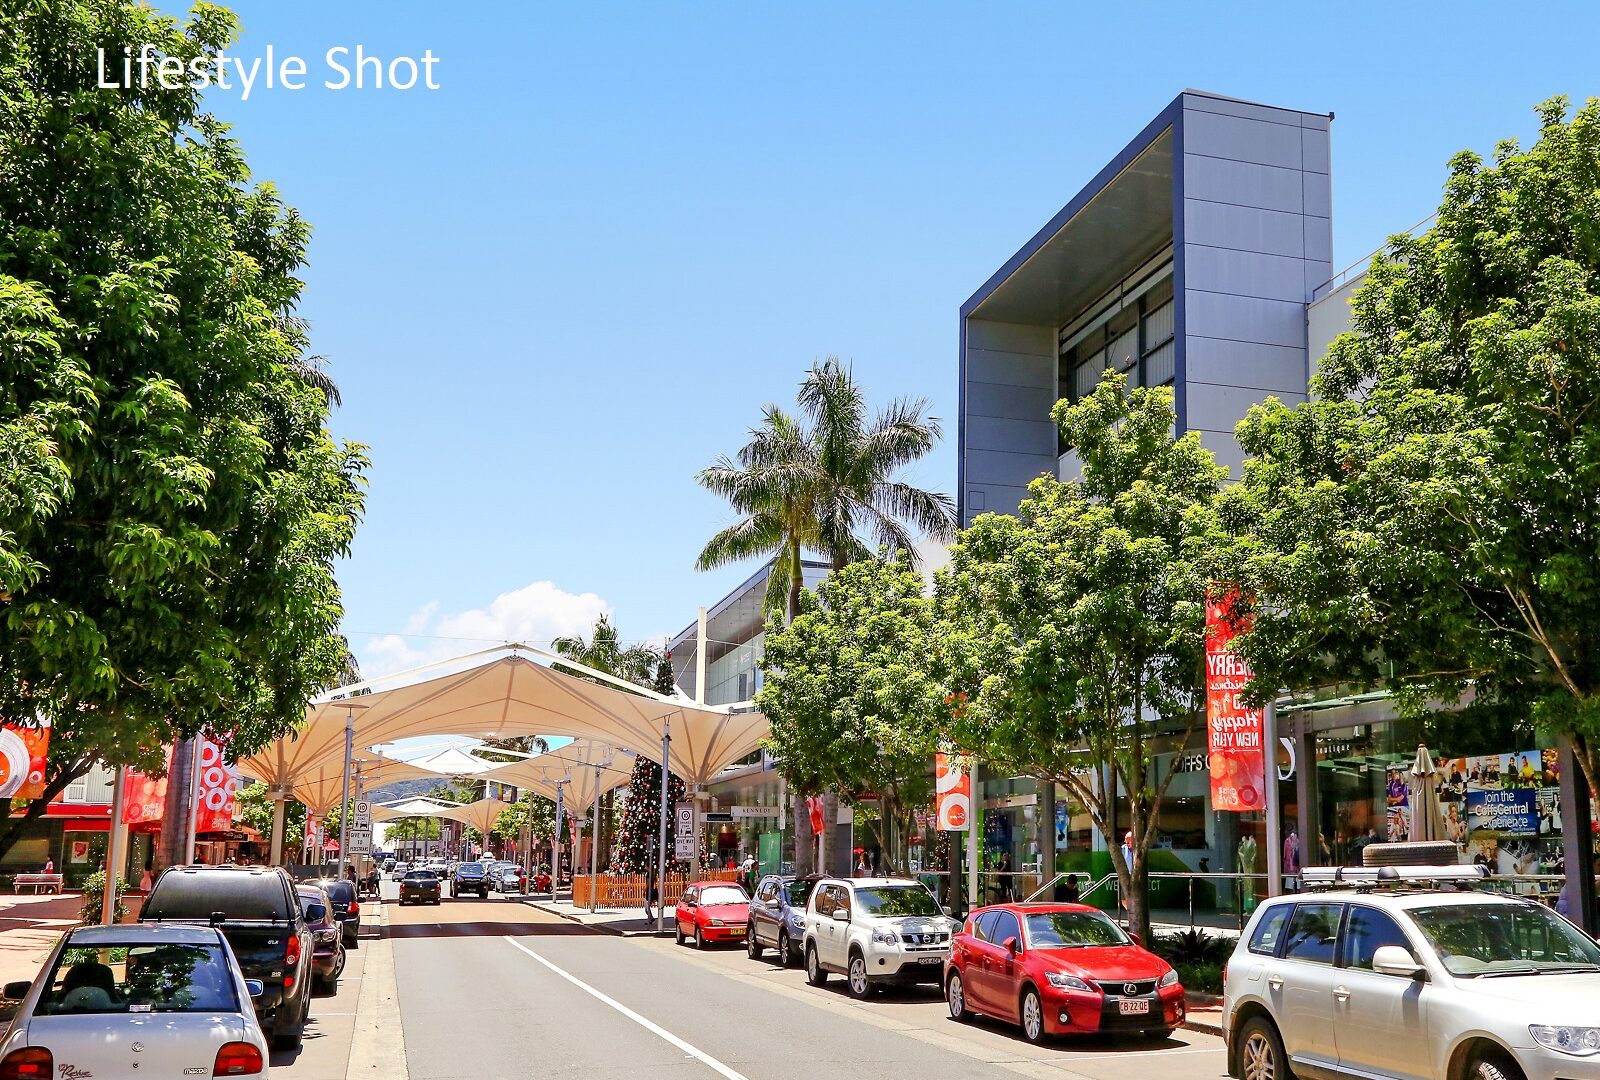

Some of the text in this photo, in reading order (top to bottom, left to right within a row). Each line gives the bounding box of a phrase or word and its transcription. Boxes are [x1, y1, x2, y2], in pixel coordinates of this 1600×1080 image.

[1484, 790, 1515, 806] join the
[1475, 802, 1528, 816] CoffsCentral
[1482, 818, 1528, 830] experience
